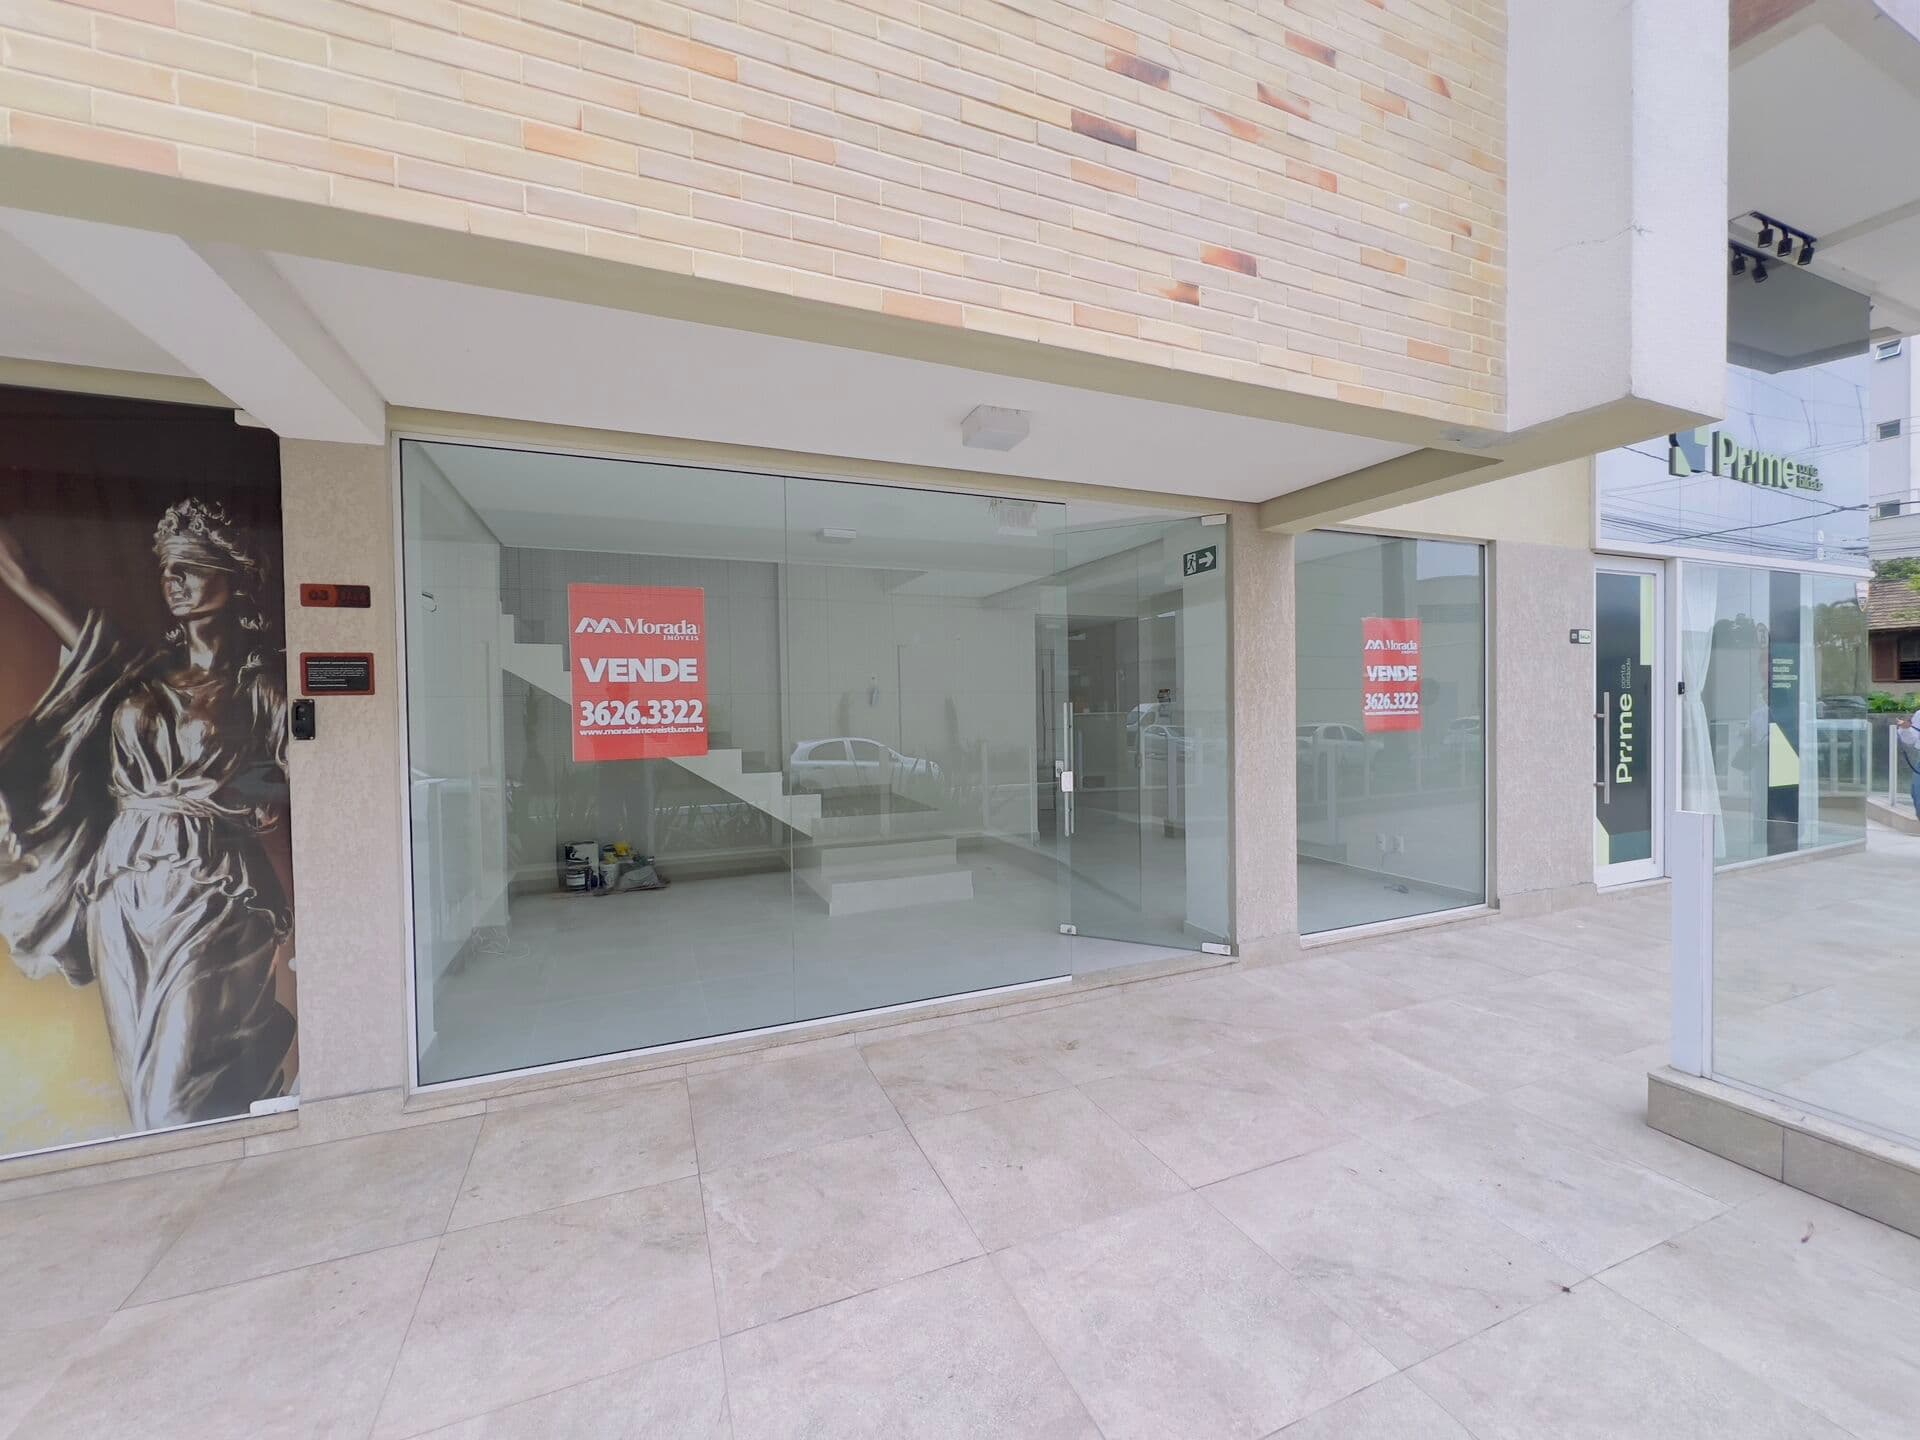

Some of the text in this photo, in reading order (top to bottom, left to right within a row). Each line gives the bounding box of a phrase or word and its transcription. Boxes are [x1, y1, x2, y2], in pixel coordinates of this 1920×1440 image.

[1712, 430, 1798, 489] Prime
[624, 617, 699, 635] Morada
[579, 657, 698, 683] VENDE
[1366, 665, 1418, 682] VENDE
[579, 699, 704, 727] 3626.3322
[1364, 692, 1419, 710] 3626.3322
[1615, 692, 1633, 784] Prime
